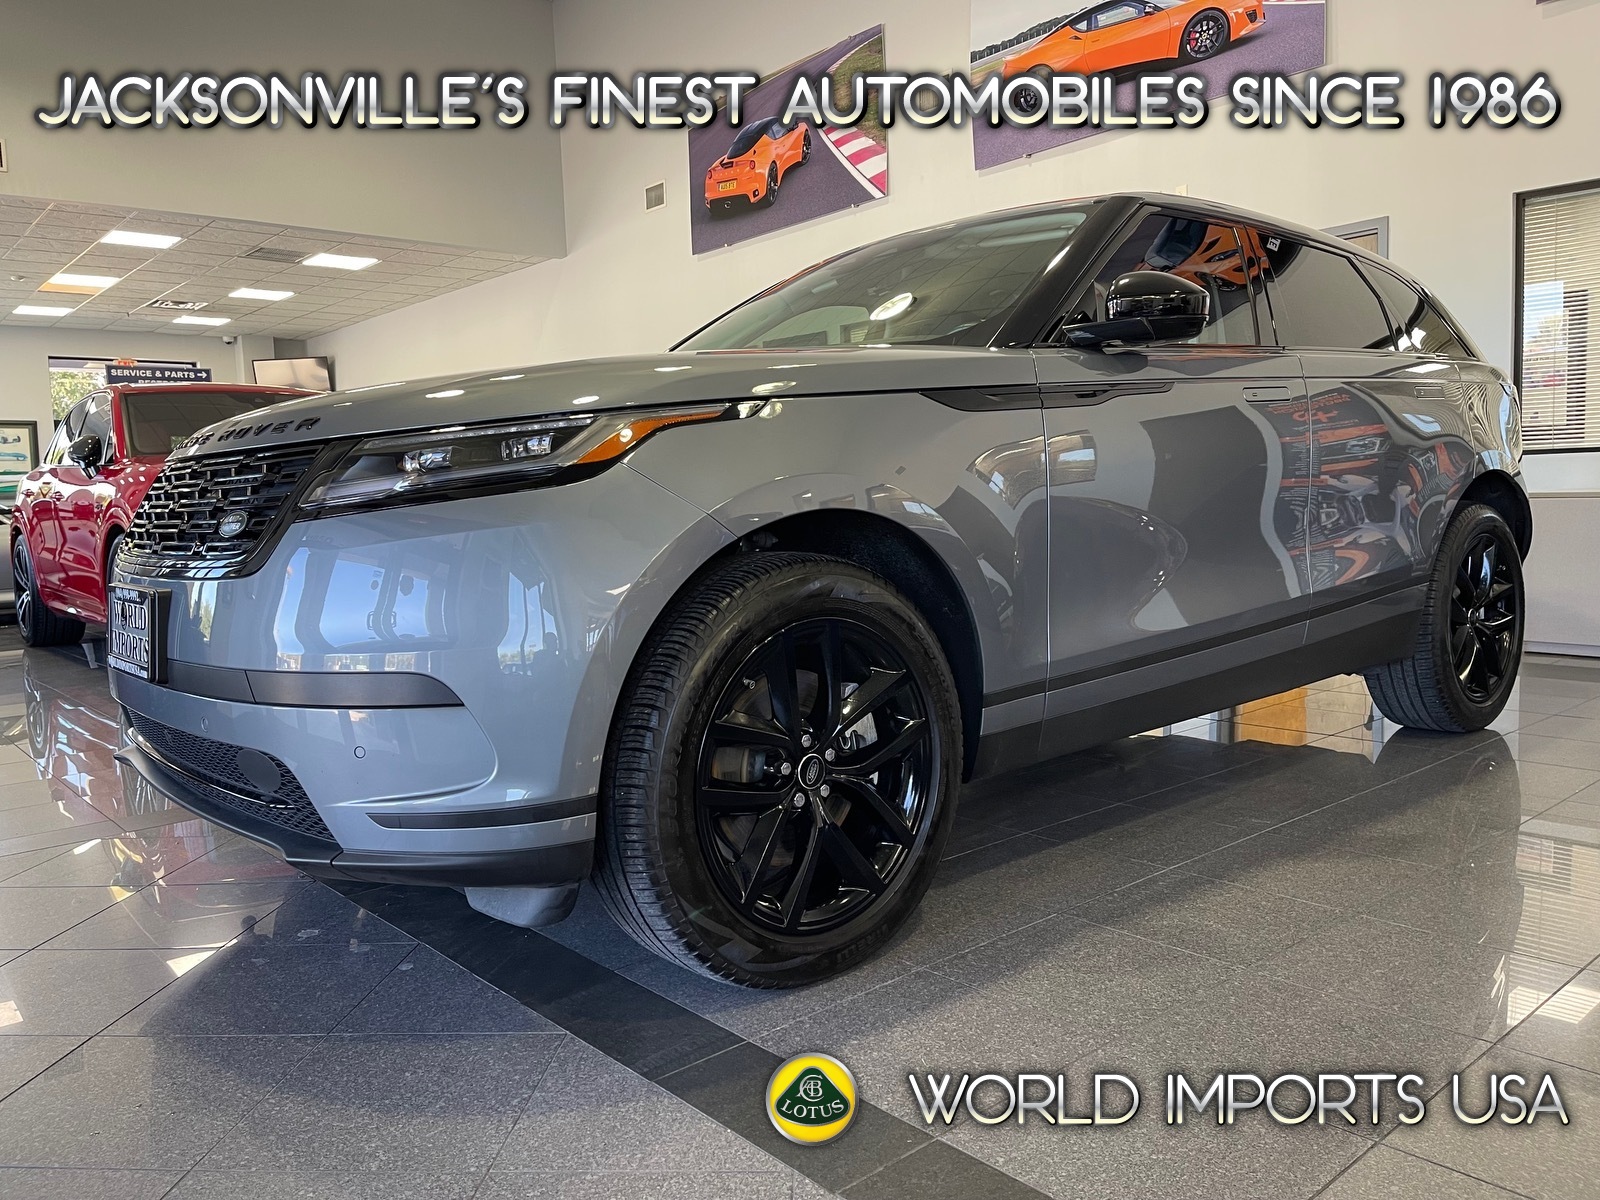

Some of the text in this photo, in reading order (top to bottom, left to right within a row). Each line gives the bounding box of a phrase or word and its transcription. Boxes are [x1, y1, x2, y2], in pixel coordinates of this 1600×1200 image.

[110, 368, 152, 377] SERVICE
[165, 371, 195, 379] PARTS
[217, 416, 321, 443] ROVER
